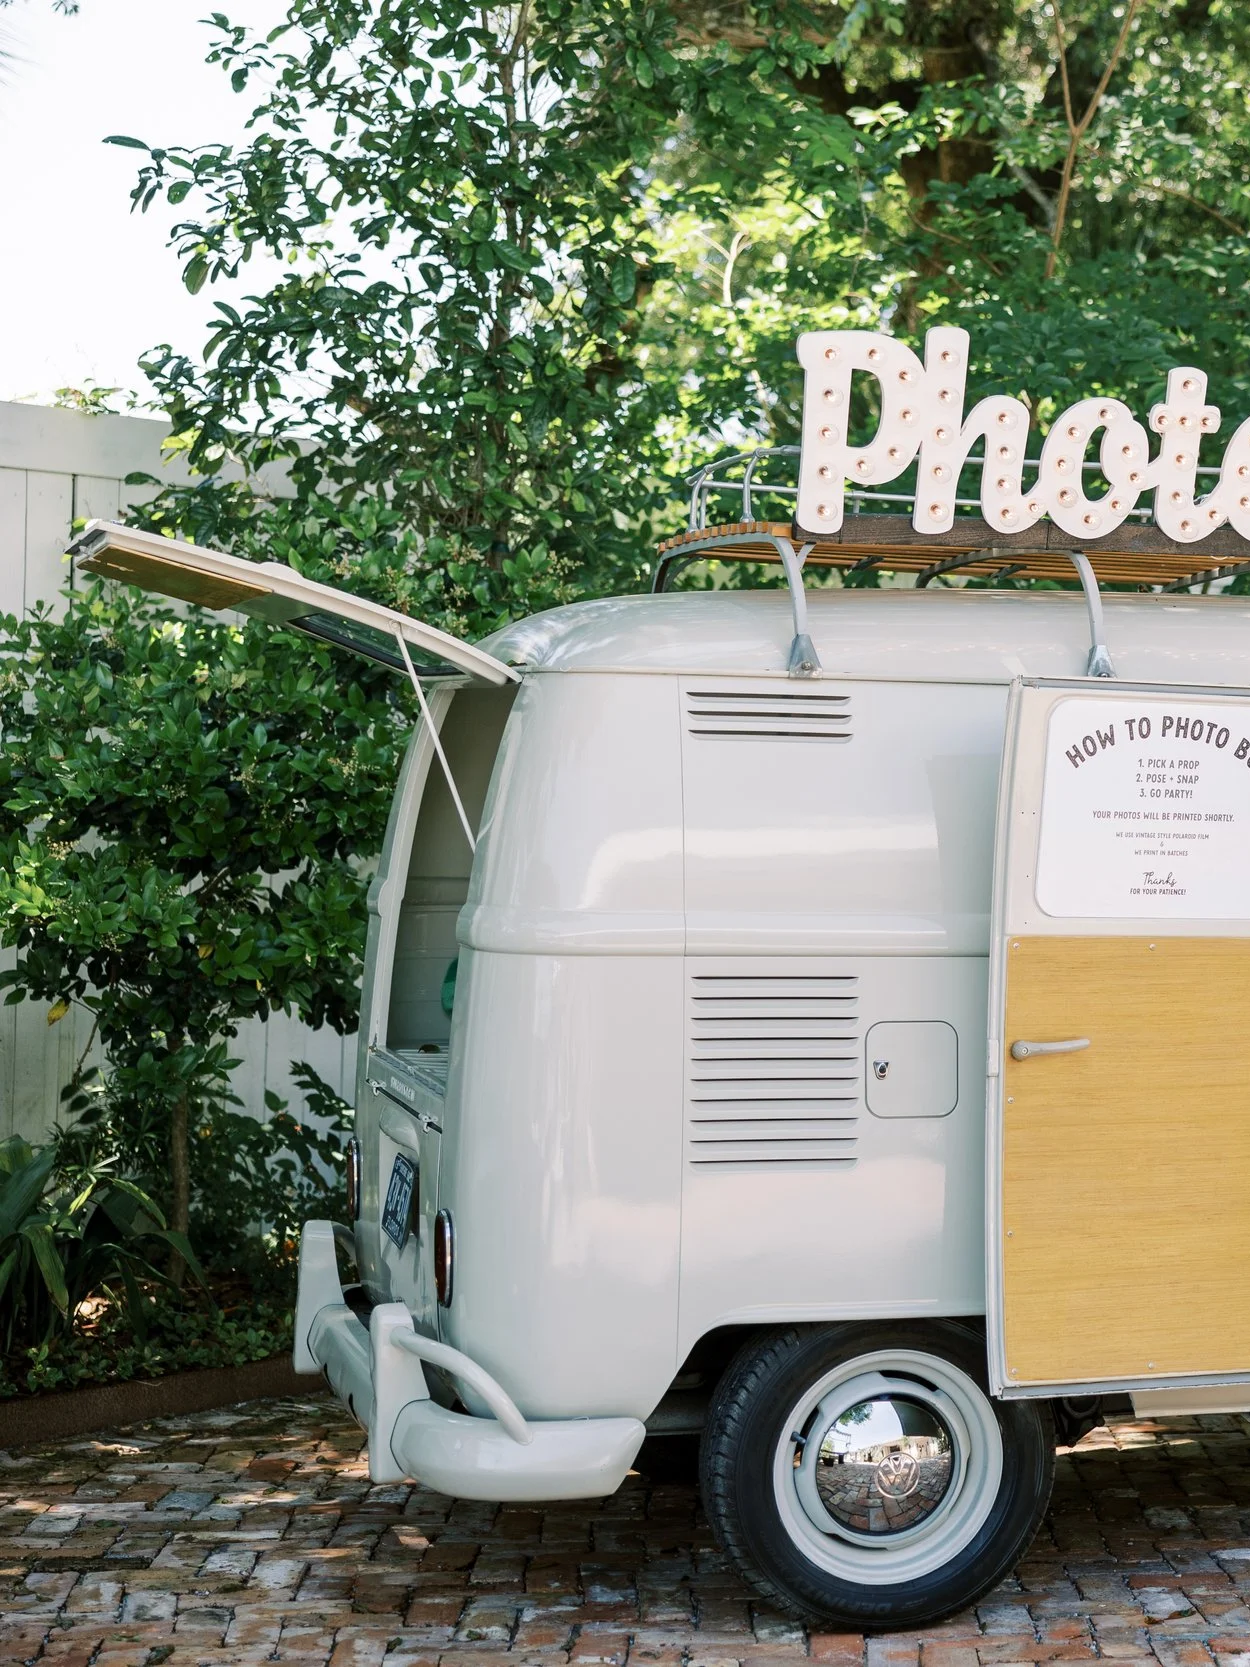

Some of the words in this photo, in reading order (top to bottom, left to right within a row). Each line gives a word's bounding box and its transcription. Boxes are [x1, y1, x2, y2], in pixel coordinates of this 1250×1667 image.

[1065, 724, 1116, 768] HOW
[1125, 717, 1151, 741] TO
[1162, 716, 1230, 748] PHOTO
[1138, 759, 1145, 768] 1.
[1148, 760, 1166, 768] PICK
[1169, 760, 1175, 769] A
[1178, 761, 1200, 770] PROP
[1136, 774, 1143, 782] 2.
[1146, 774, 1166, 783] POSE
[1177, 775, 1199, 784] SNAP
[1139, 789, 1146, 797] 3.
[1150, 789, 1161, 798] GO
[1165, 790, 1193, 799] PARTY!
[1114, 811, 1140, 819] PHOTOS
[1143, 812, 1159, 820] WILL
[1173, 813, 1202, 821] PRINTED
[1204, 813, 1234, 822] SHORTLY.
[1143, 872, 1177, 887] Thanks
